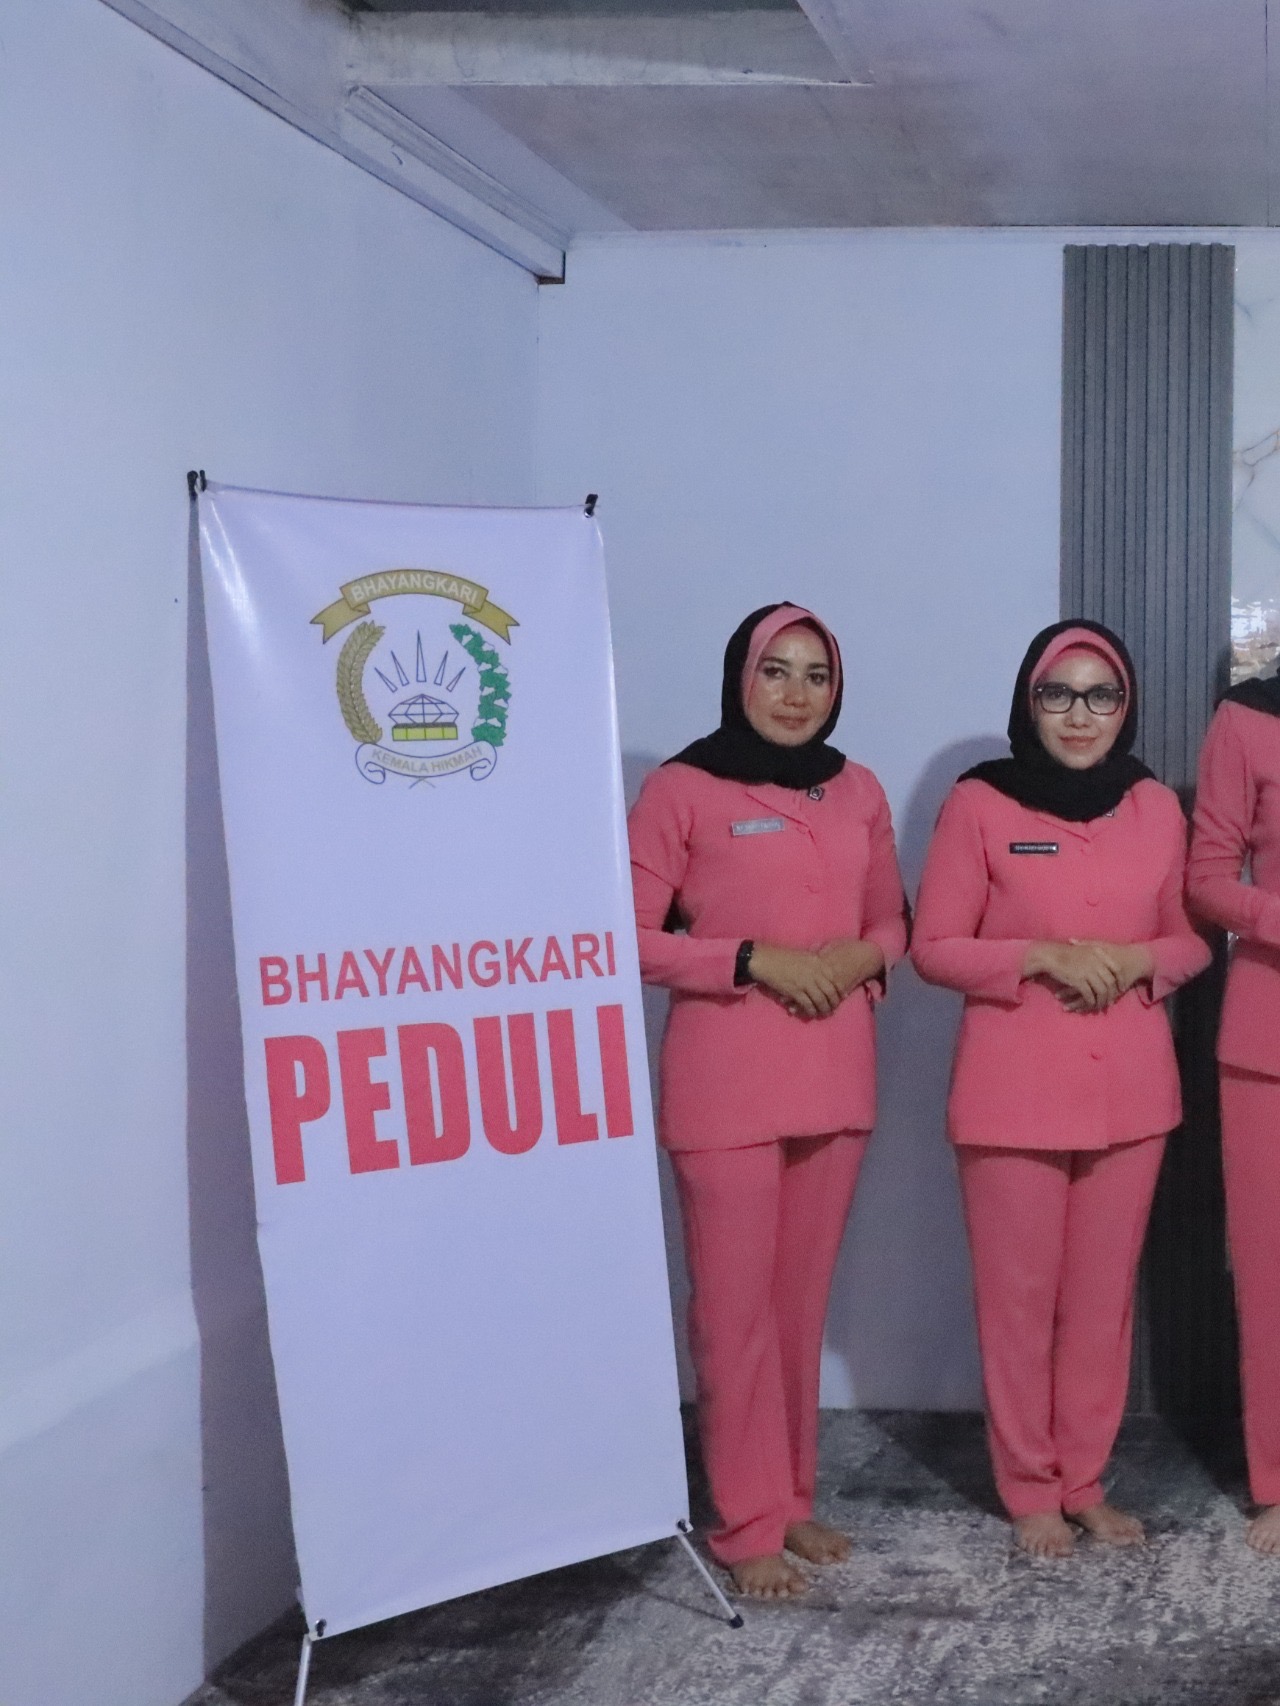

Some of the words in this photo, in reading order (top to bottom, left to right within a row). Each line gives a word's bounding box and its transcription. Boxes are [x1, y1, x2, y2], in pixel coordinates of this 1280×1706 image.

[351, 573, 479, 605] BHAYANGKARI
[371, 748, 429, 773] KEMALA
[432, 746, 482, 773] HIKMAH
[259, 931, 617, 1006] BHAYANGKARI
[263, 1004, 635, 1185] PEDULI
